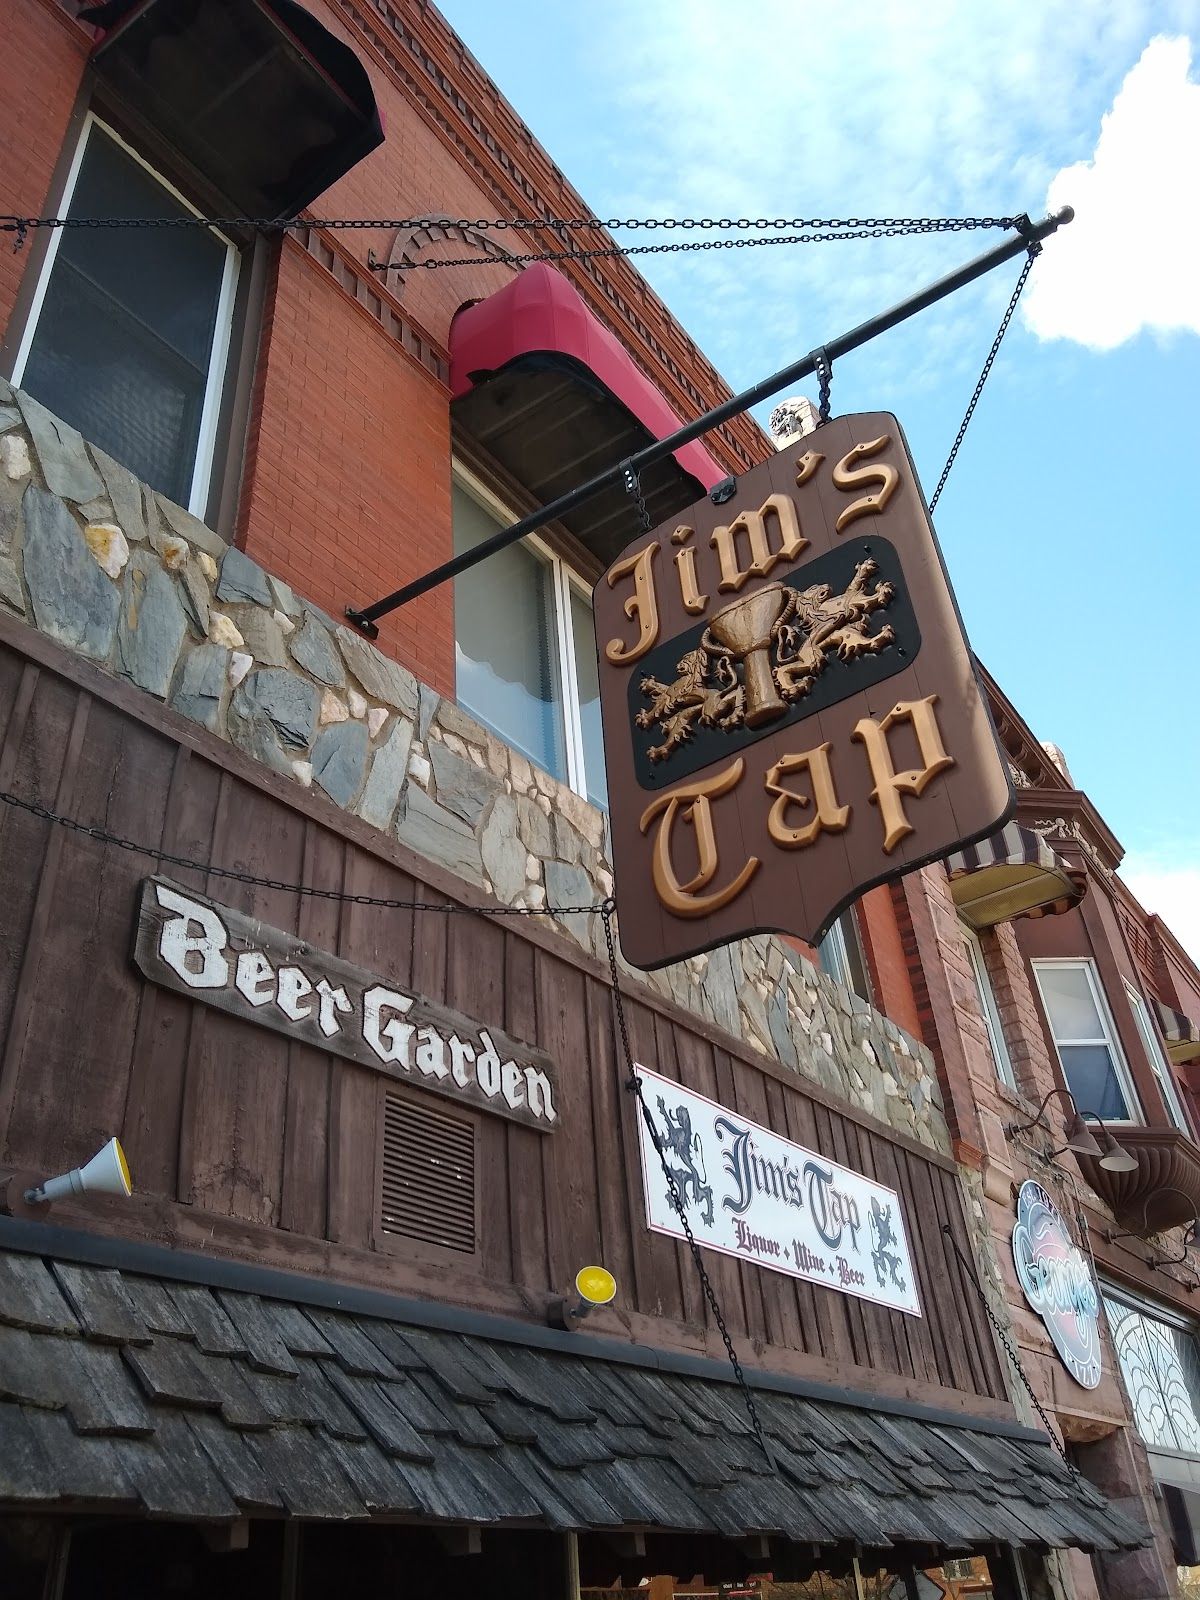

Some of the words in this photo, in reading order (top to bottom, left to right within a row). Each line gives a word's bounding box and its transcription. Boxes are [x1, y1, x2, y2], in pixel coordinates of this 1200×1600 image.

[605, 434, 900, 666] Jim's
[639, 694, 956, 920] Tap
[155, 884, 354, 1038] Beer
[362, 984, 558, 1123] Garden
[714, 1115, 803, 1215] Jim's
[803, 1160, 862, 1255] Tap
[732, 1217, 780, 1257] Liquor
[792, 1238, 826, 1273] Wine
[836, 1255, 865, 1288] Beer
